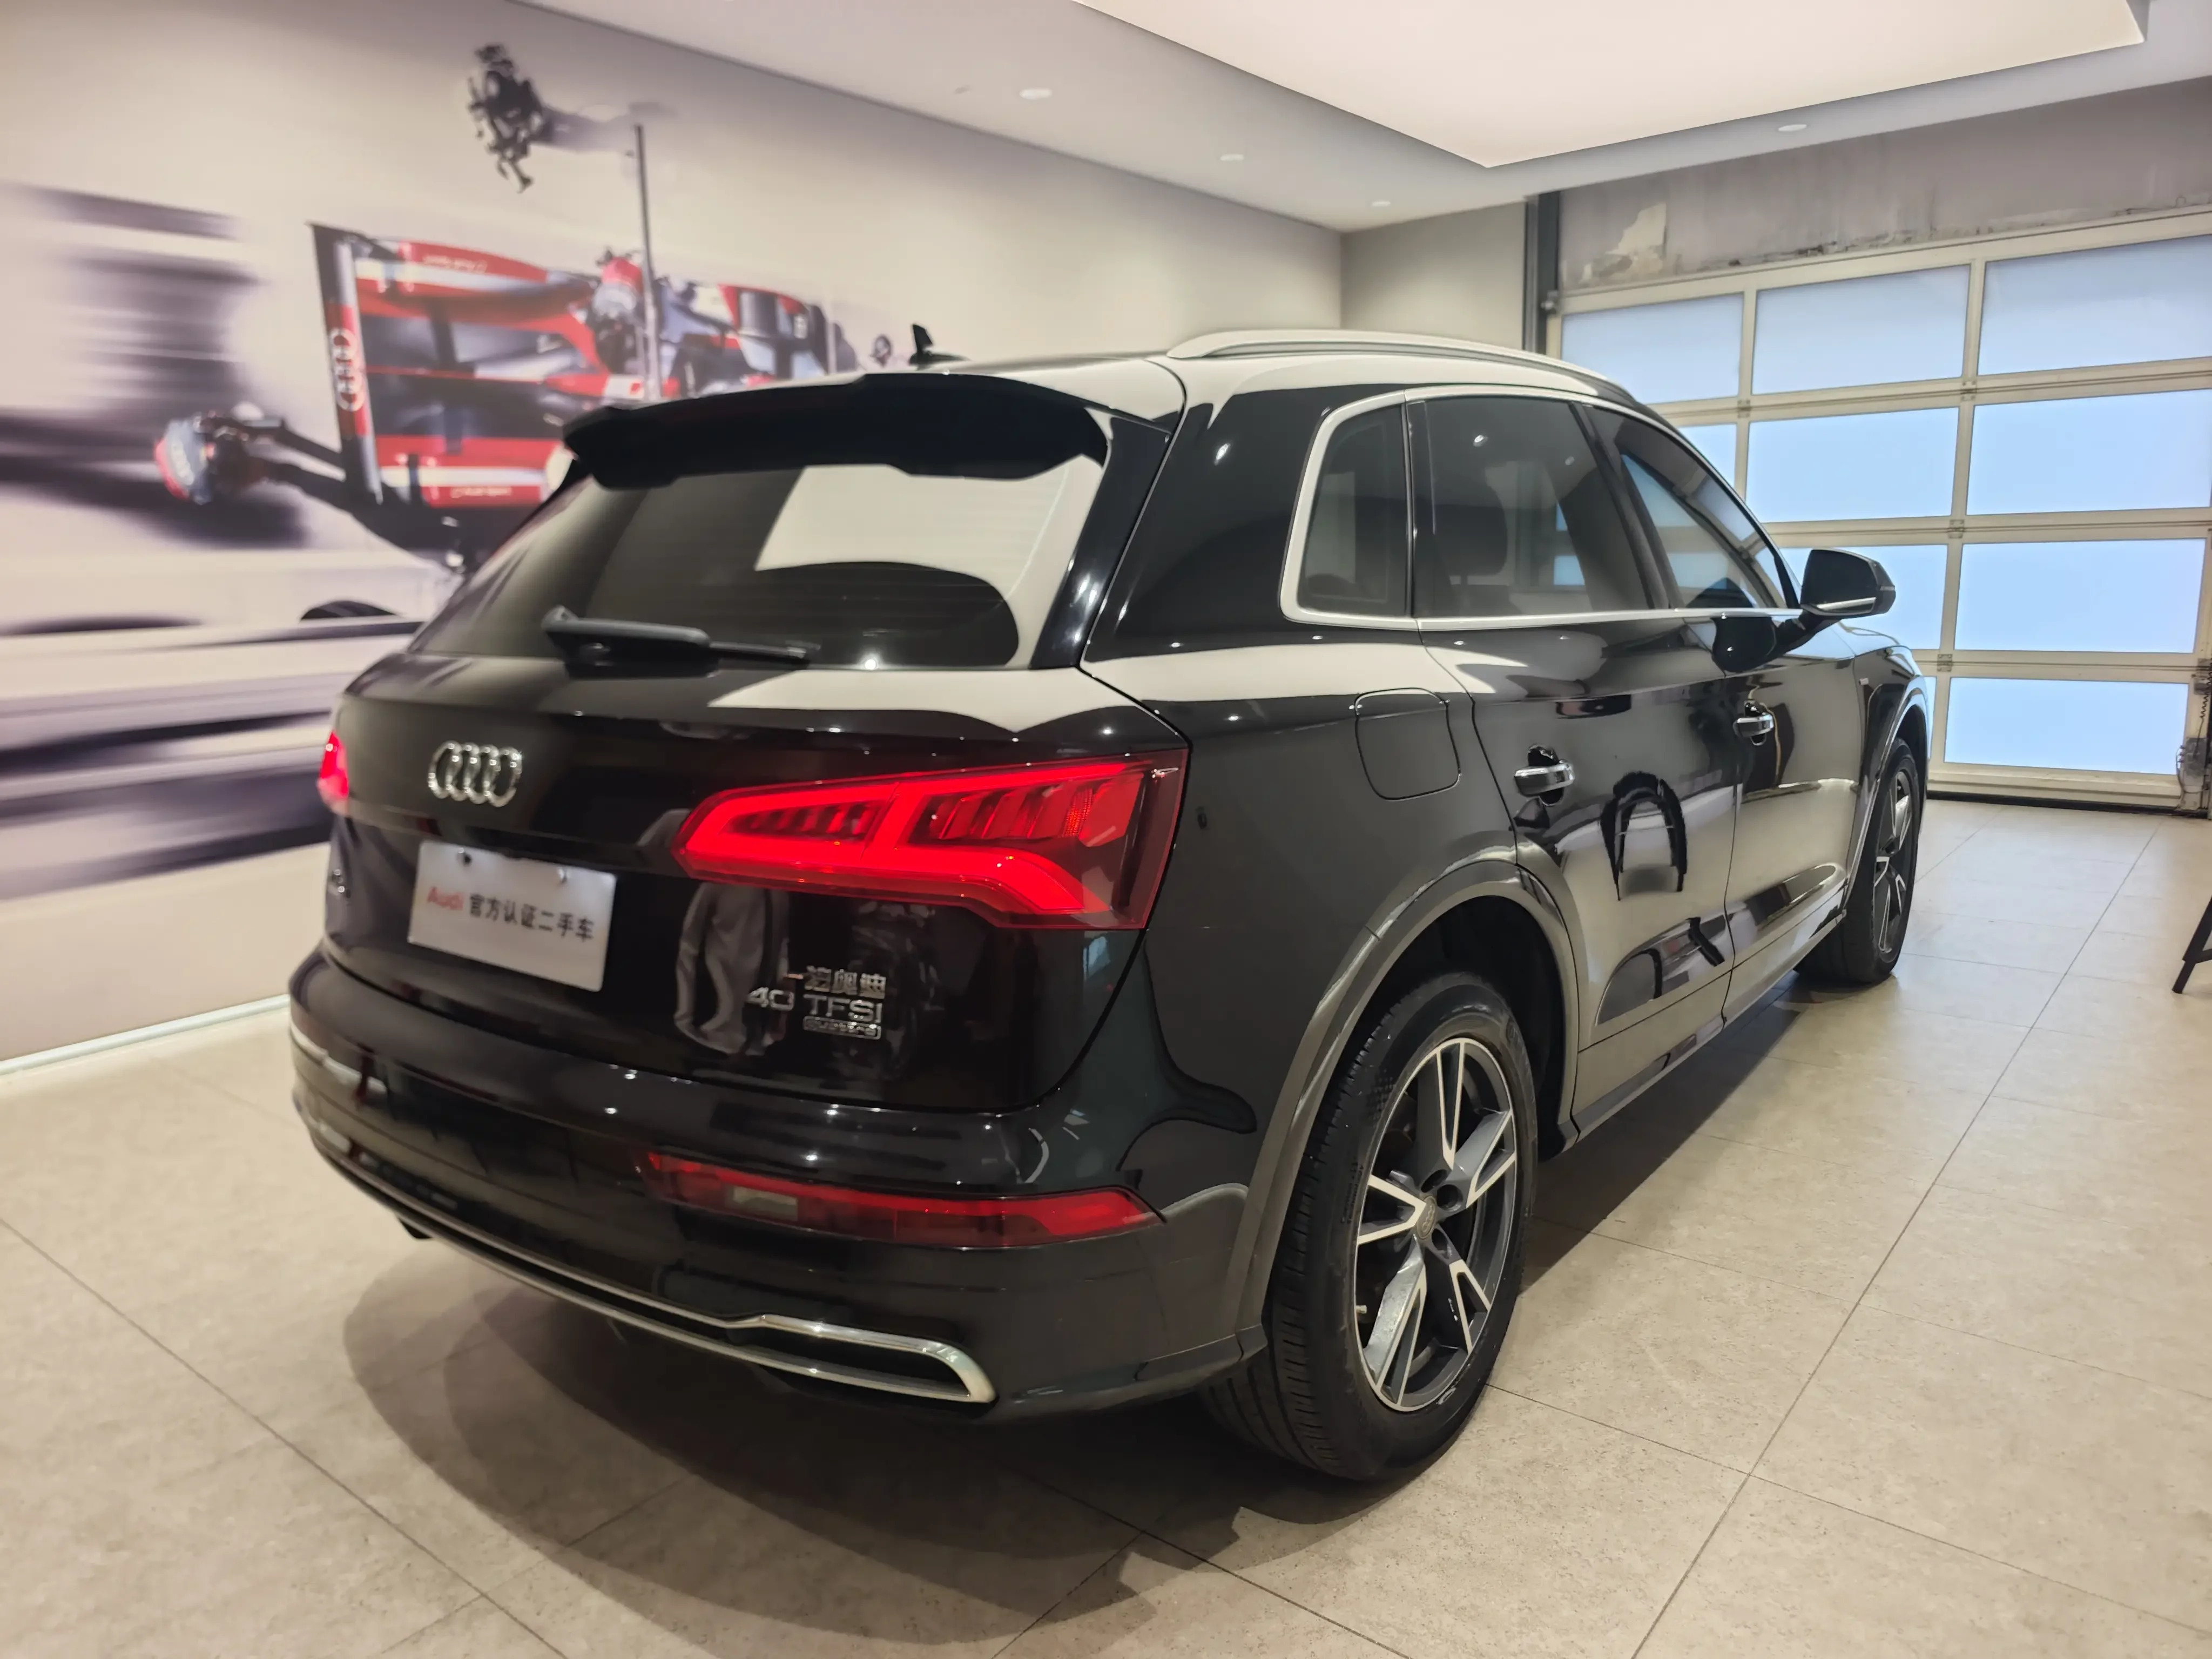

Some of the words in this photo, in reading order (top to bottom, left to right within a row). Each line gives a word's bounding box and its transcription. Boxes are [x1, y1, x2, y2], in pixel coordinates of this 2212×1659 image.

[427, 886, 464, 911] Audi
[469, 893, 594, 942] 官方认证二手车
[748, 987, 794, 1011] 40
[804, 993, 882, 1023] TFSI
